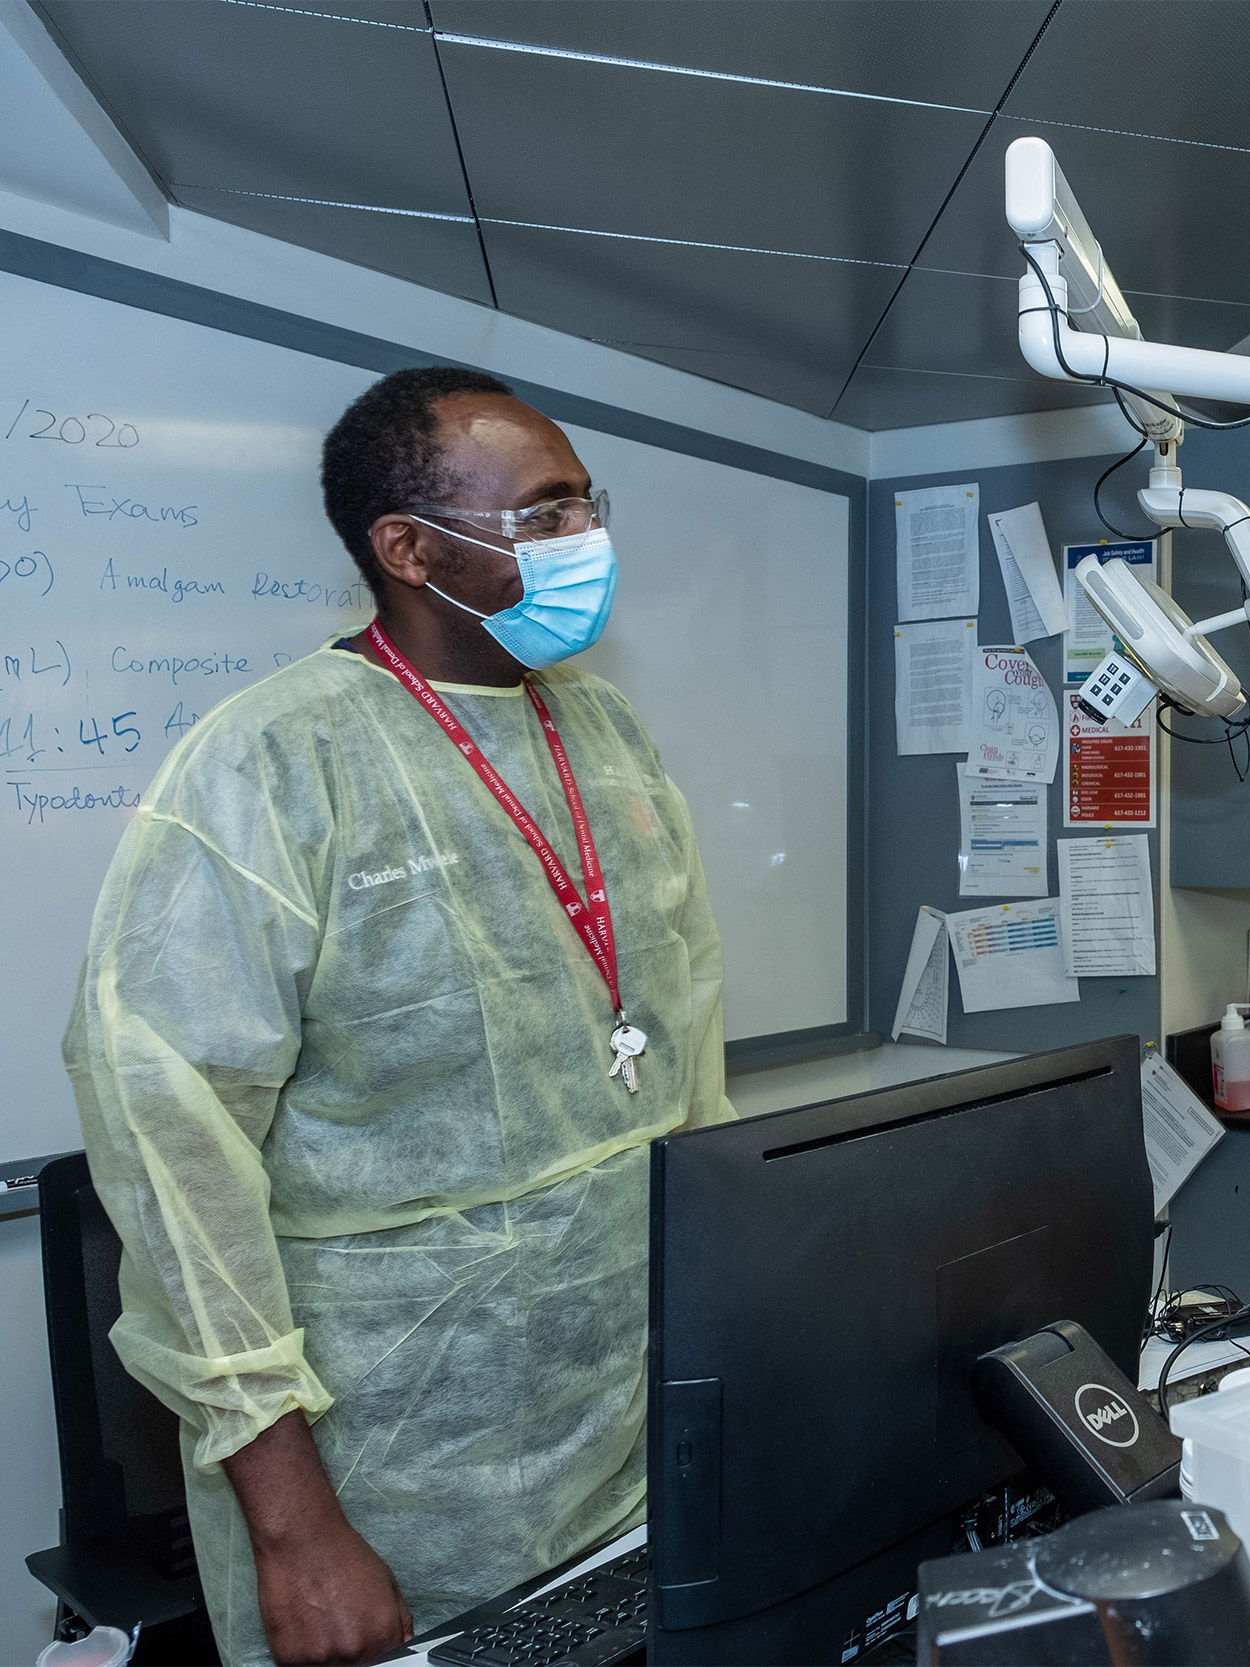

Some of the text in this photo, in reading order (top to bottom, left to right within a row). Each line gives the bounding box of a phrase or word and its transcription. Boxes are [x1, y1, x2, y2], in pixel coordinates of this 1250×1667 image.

[64, 484, 198, 528] Exams
[1111, 549, 1123, 557] Safety
[100, 557, 225, 603] Amalgam
[112, 646, 254, 685] Composite
[380, 644, 400, 665] Dental
[396, 661, 405, 671] of
[402, 667, 425, 691] School
[1004, 670, 1045, 690] Cough
[421, 691, 457, 731] HARVARD
[7, 781, 141, 824] Typodonts
[554, 744, 572, 787] HARVARD
[583, 843, 595, 877] Medicine
[480, 763, 568, 890] HARVARD School of Dental Medicine
[348, 865, 407, 890] Charles
[583, 924, 604, 960] Medicine
[1086, 1401, 1128, 1431] DELL
